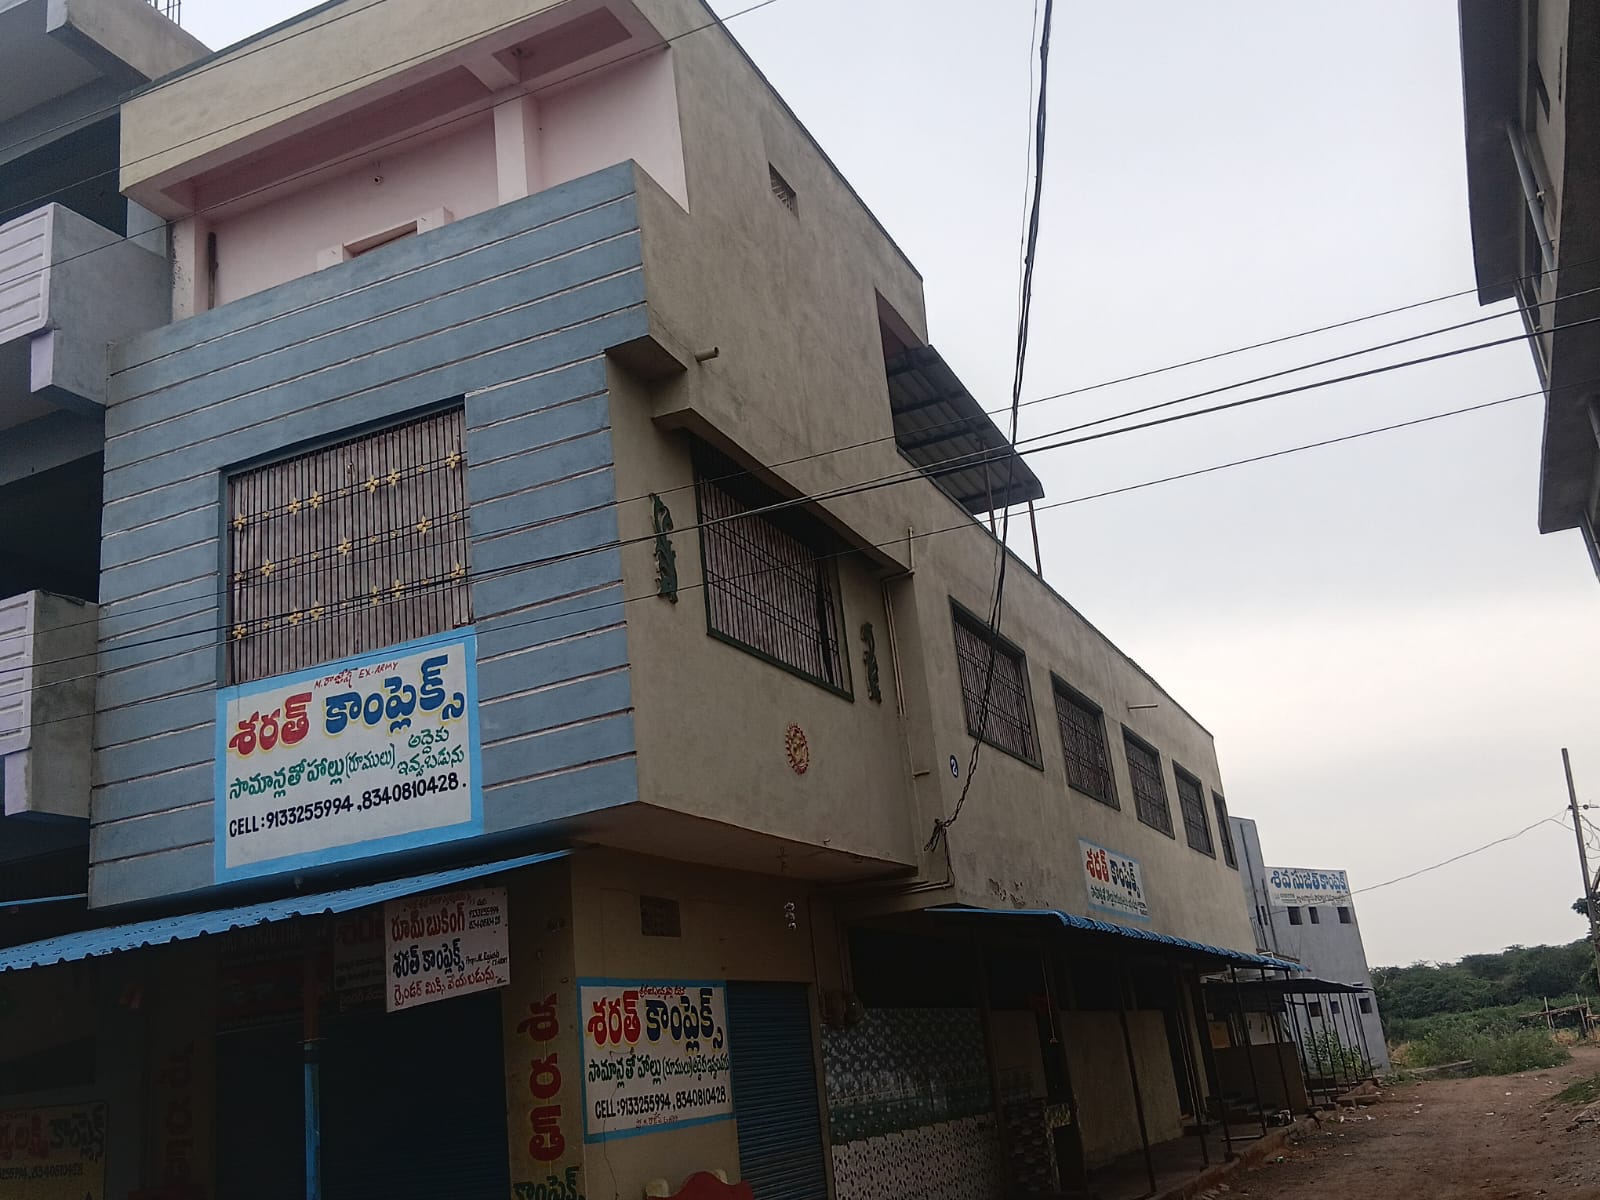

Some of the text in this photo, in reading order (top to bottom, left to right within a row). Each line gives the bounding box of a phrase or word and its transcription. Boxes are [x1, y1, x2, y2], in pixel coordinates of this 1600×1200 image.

[229, 655, 464, 755] శరత్ కాంప్లెక్స్
[408, 726, 449, 755] అద్దెకు
[393, 945, 420, 978] శరత్
[588, 988, 723, 1053] శరత్ కాంప్లెక్స్
[517, 993, 565, 1161] శరత్
